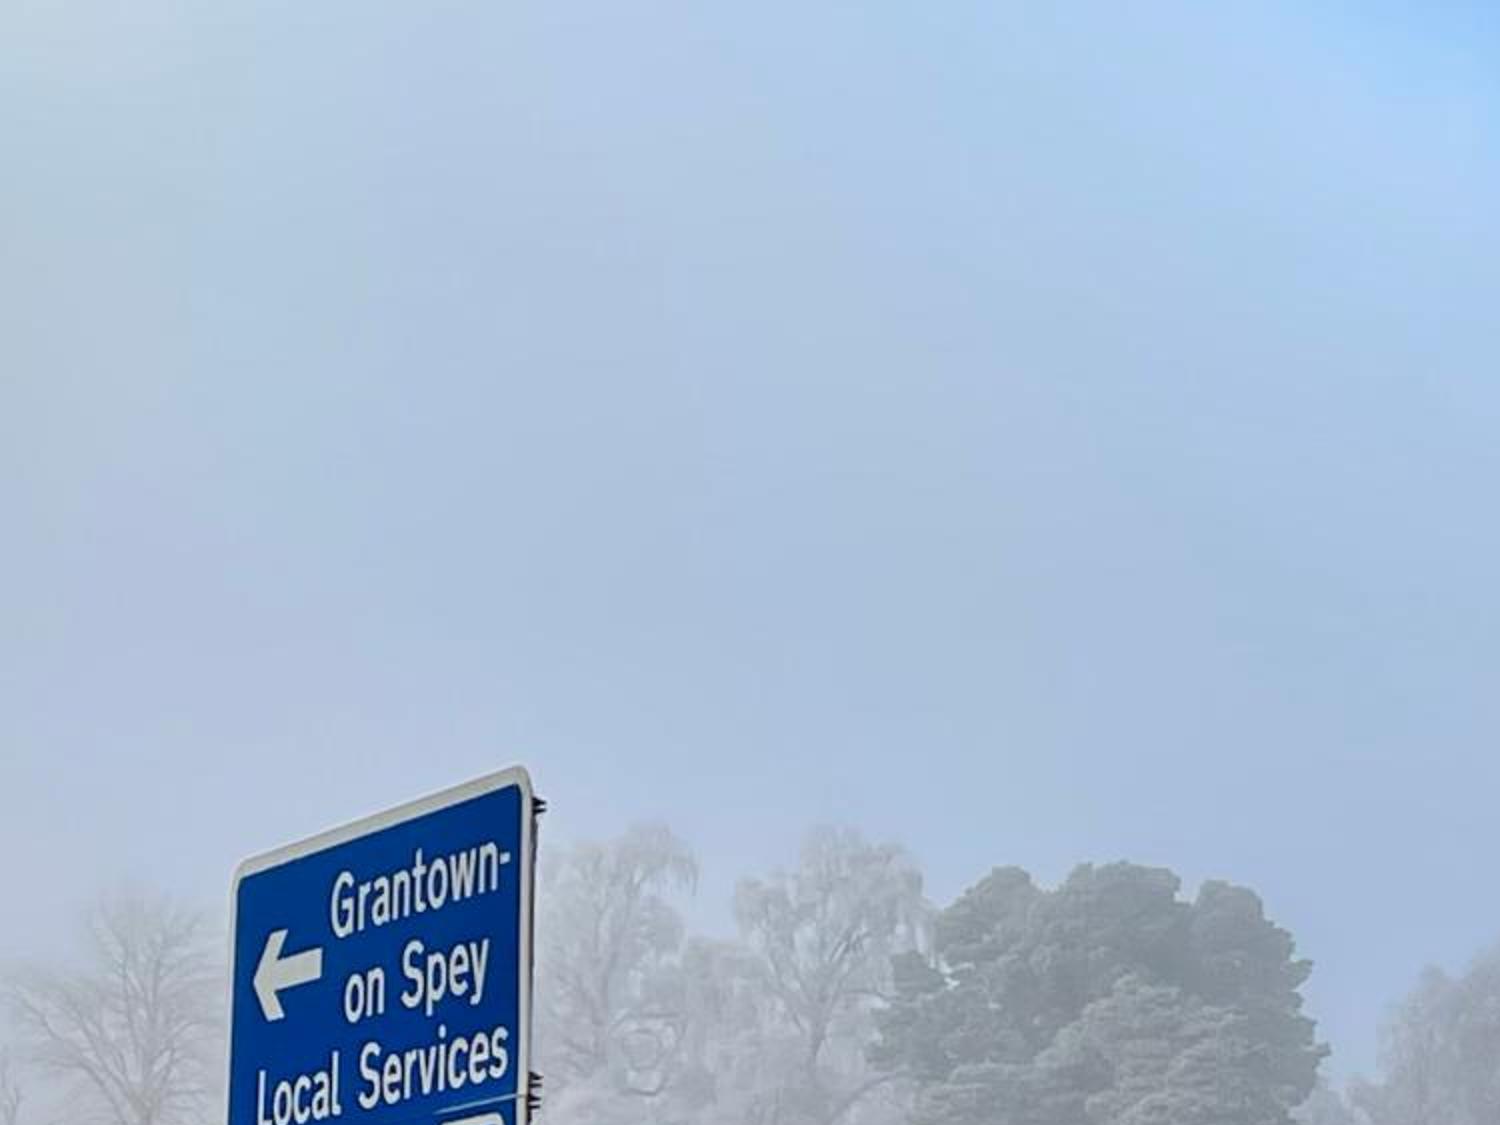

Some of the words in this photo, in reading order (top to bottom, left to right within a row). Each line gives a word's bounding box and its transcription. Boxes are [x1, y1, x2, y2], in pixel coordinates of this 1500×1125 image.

[344, 966, 385, 1023] on
[400, 938, 490, 1016] Spey
[358, 1025, 509, 1110] Services
